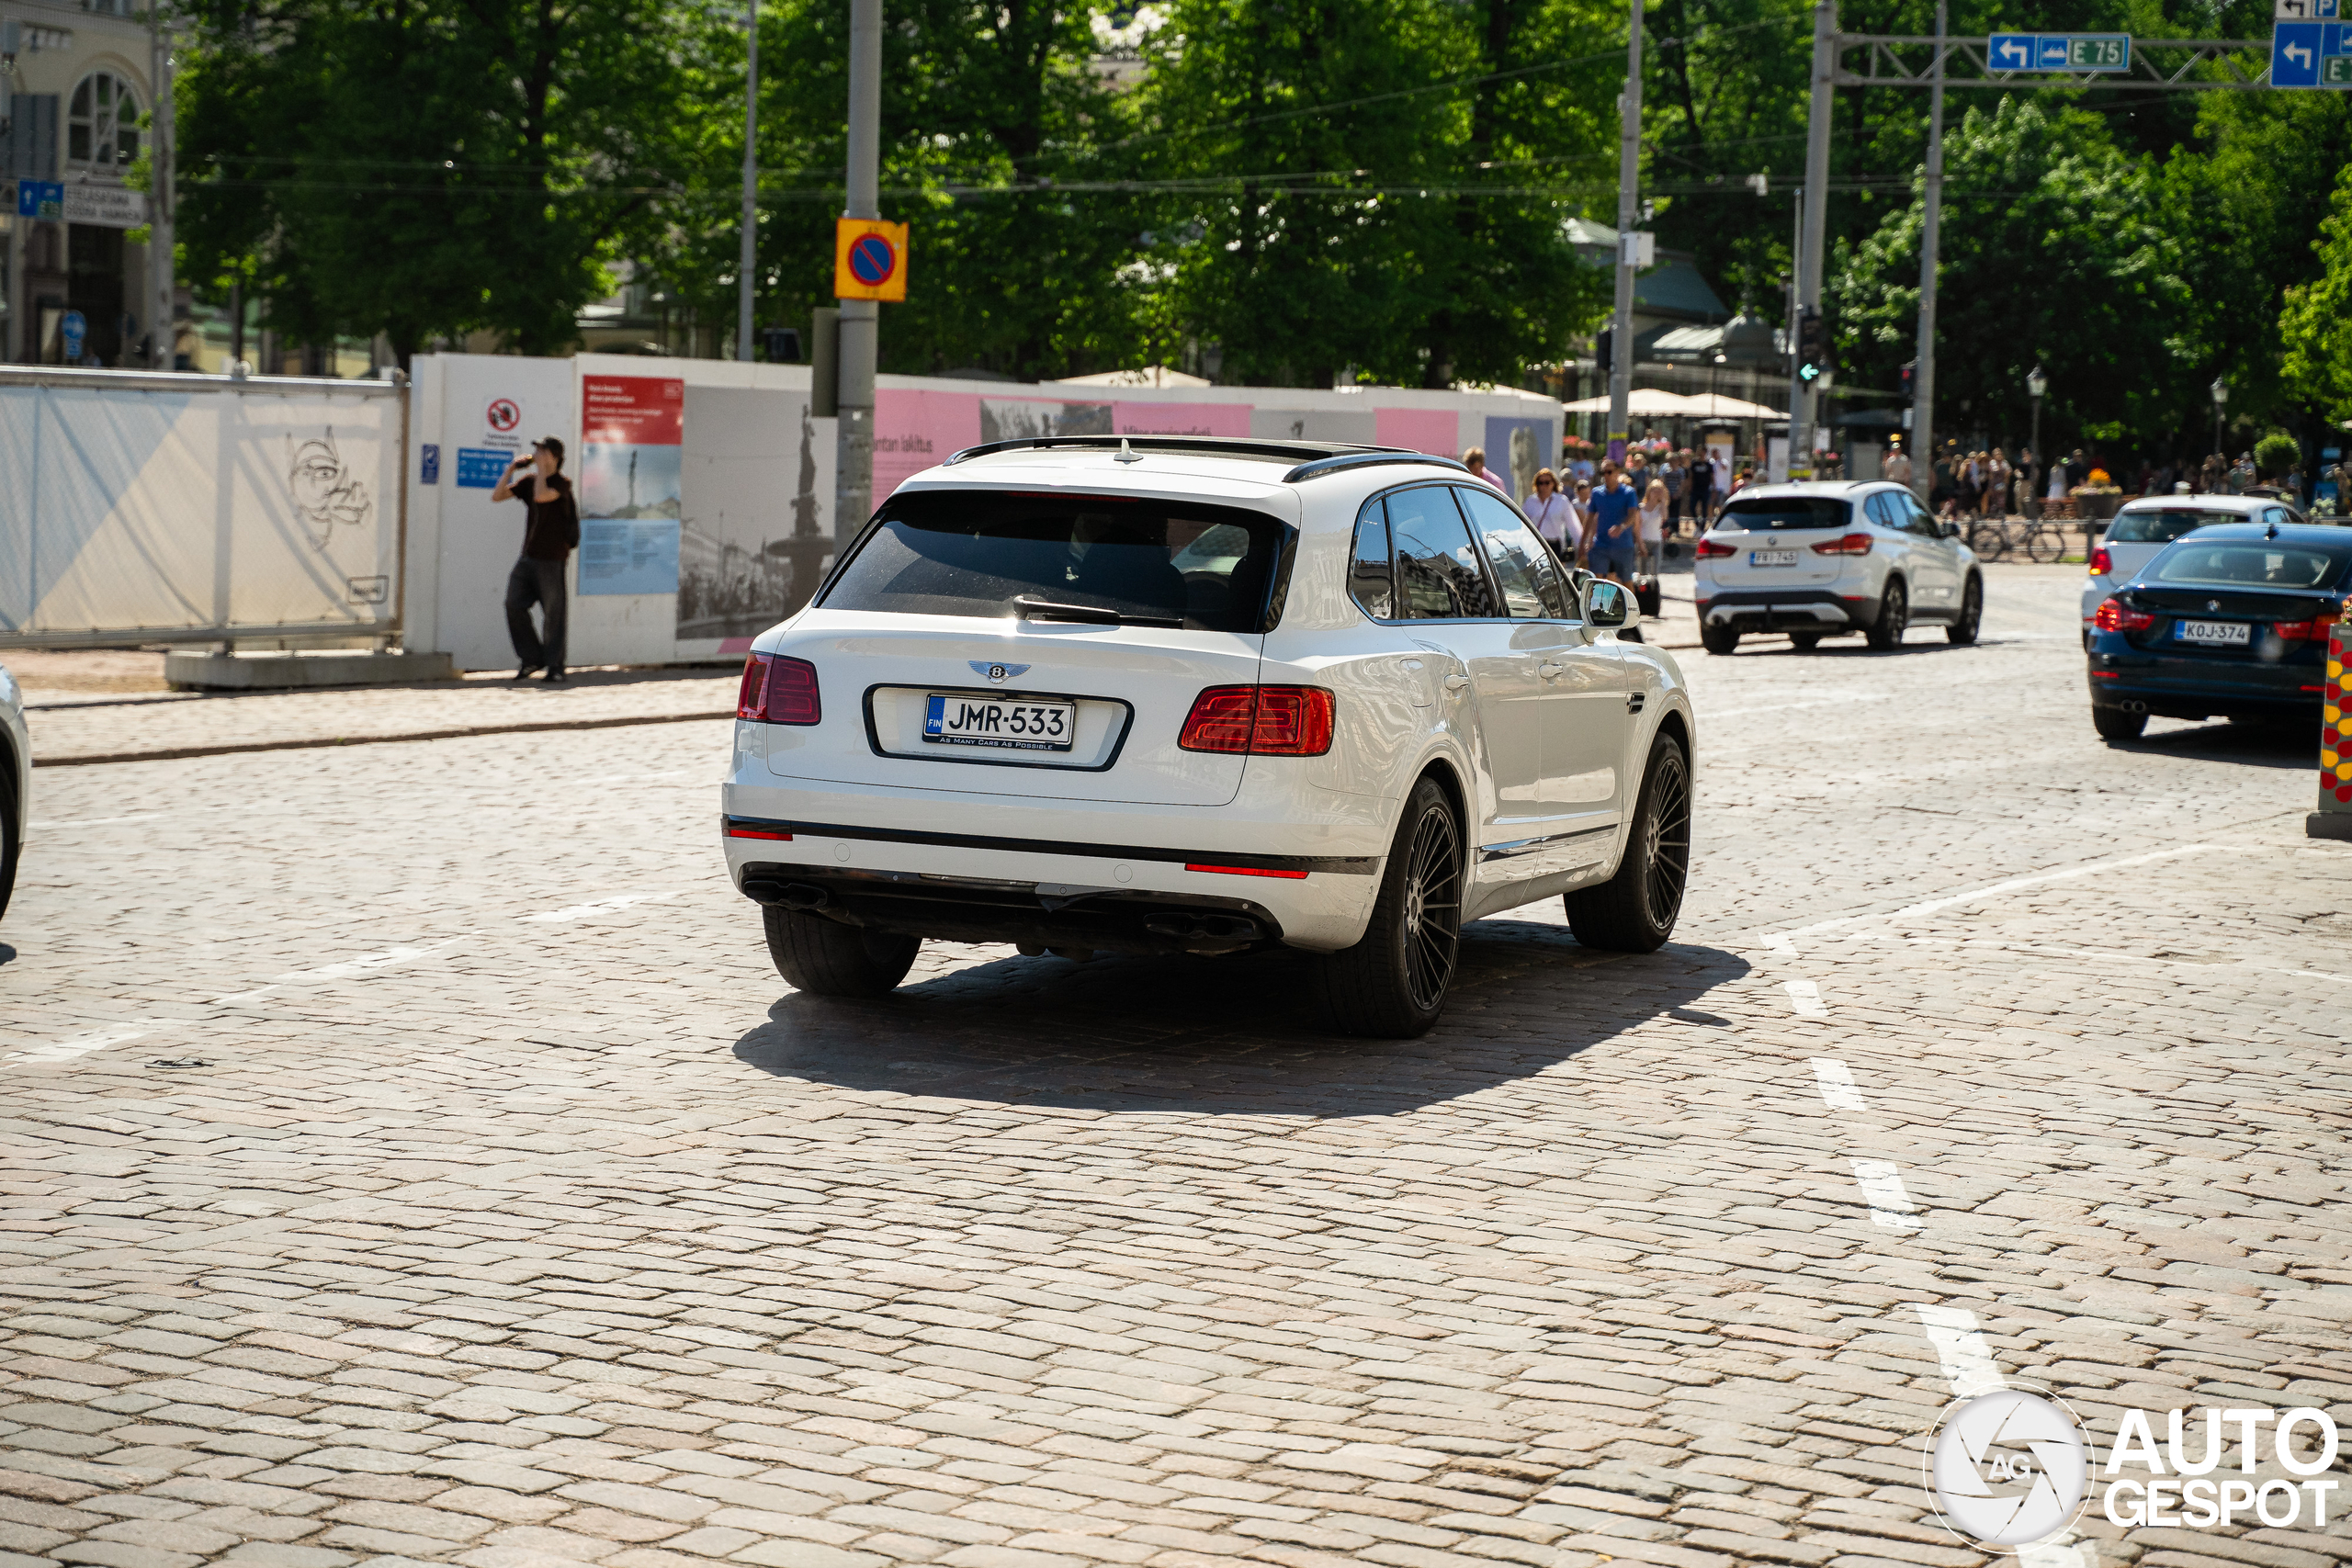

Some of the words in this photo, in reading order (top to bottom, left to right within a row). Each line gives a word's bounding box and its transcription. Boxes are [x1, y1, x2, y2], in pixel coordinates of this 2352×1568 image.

[2318, 0, 2334, 16] P
[2073, 41, 2086, 63] E
[2096, 41, 2120, 63] 75
[2330, 59, 2345, 81] E
[2187, 624, 2245, 639] KOJ-374
[991, 667, 1002, 677] B
[928, 718, 942, 728] FIN
[948, 704, 1065, 736] JMR-533
